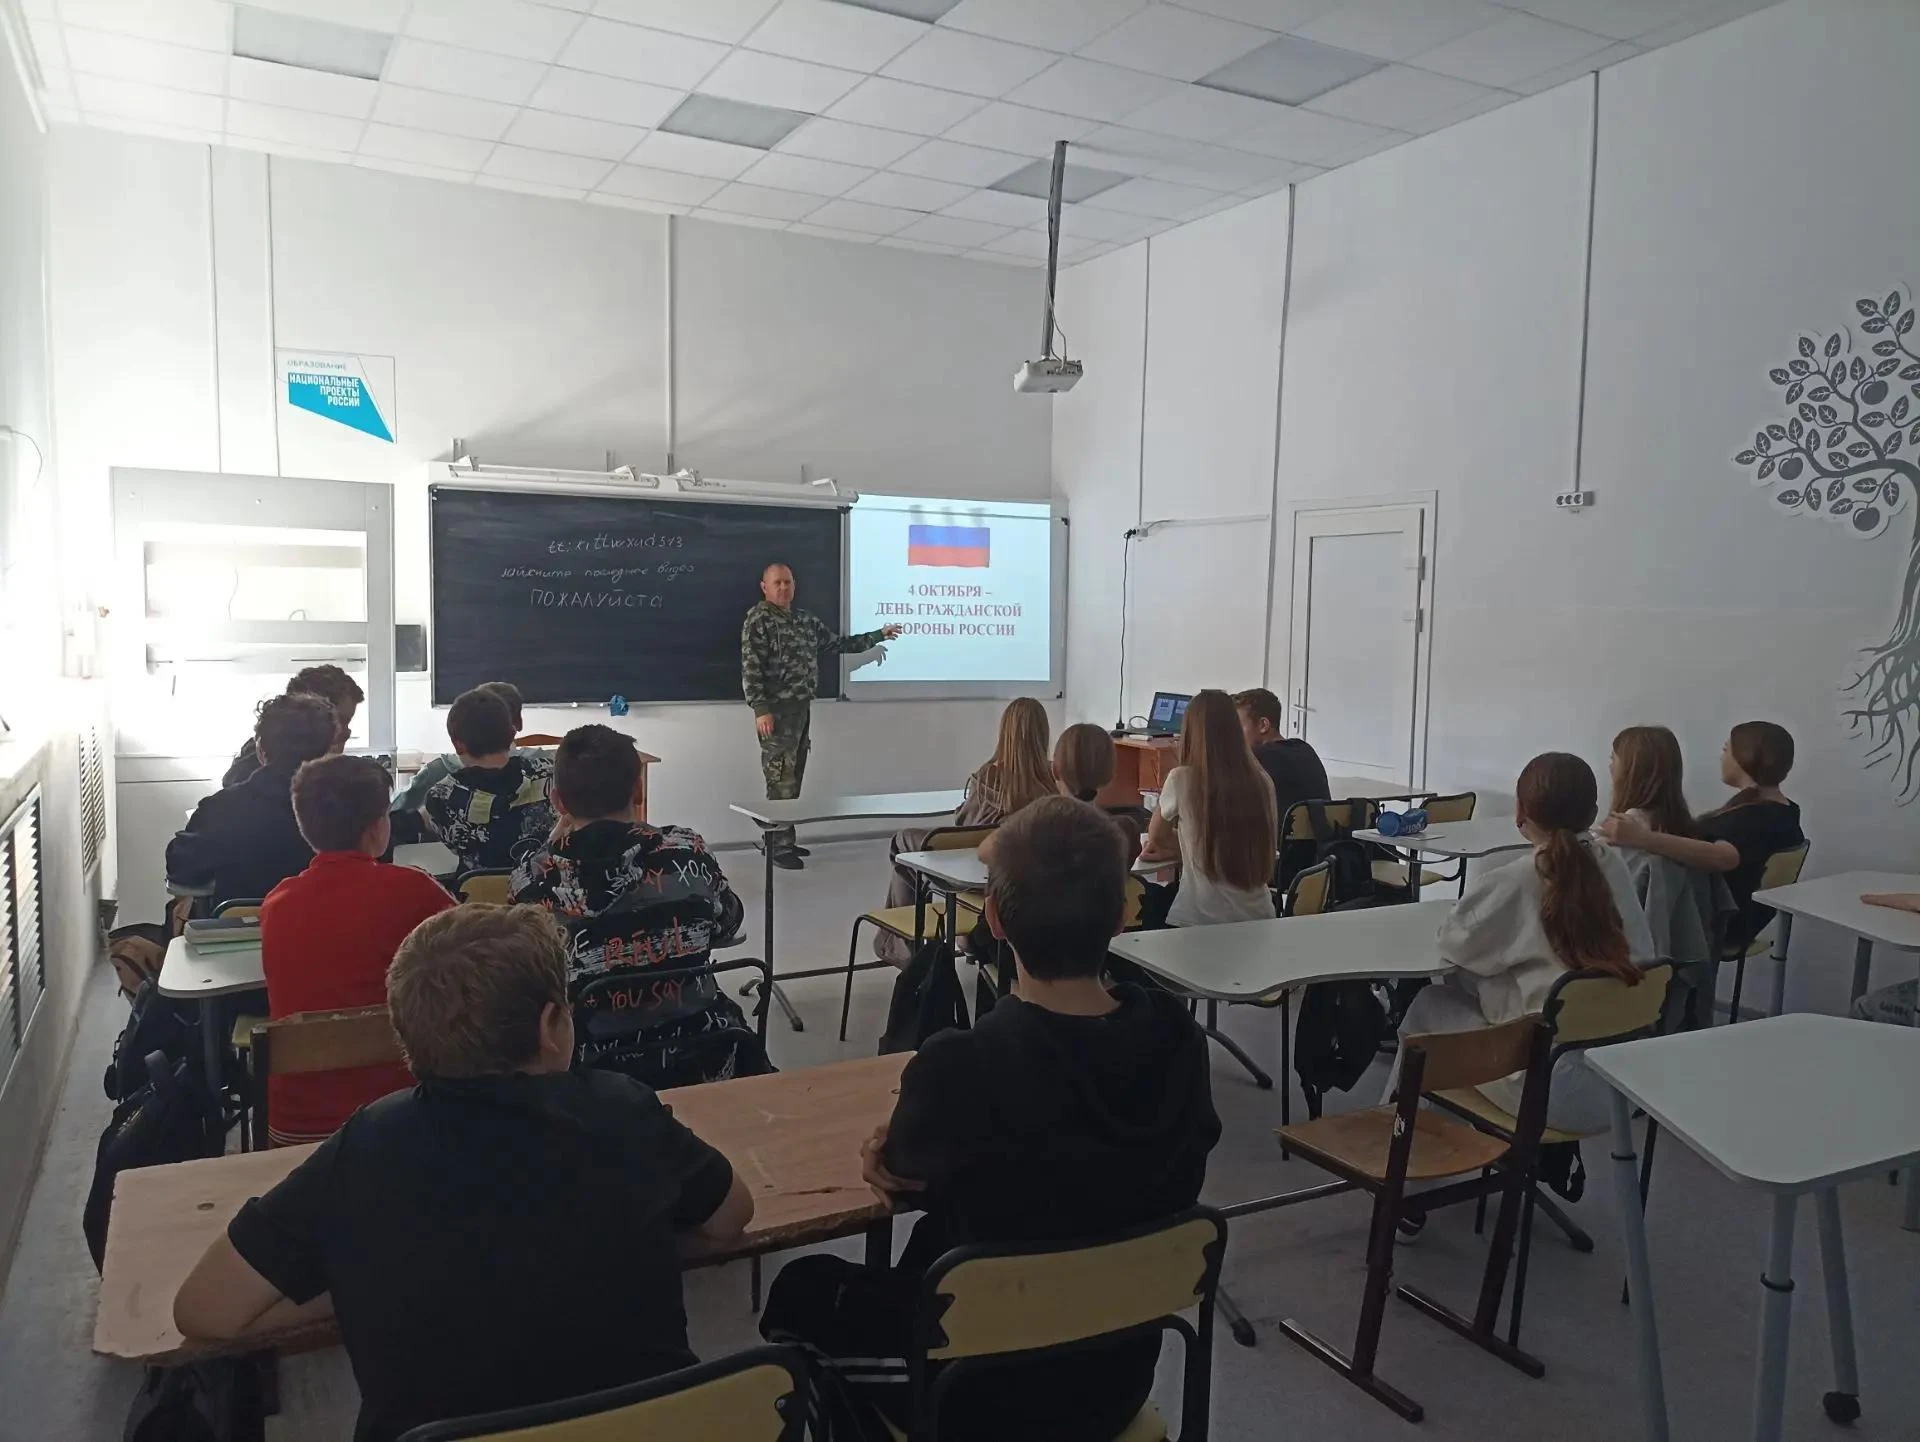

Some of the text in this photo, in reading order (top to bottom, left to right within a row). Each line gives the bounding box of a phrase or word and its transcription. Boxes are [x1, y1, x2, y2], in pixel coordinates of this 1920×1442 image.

[289, 374, 360, 388] НАЦИОНАЛЬНЫЕ
[320, 386, 360, 397] ПРОЕКТЫ
[327, 396, 360, 407] РОССИИ
[908, 585, 915, 596] 4
[918, 585, 982, 597] ОКТЯБРЯ
[875, 602, 1022, 617] ДЕНЬ ГРАЖДАНСКОЙ
[884, 622, 1015, 636] ОРОНЫ РОССИИ
